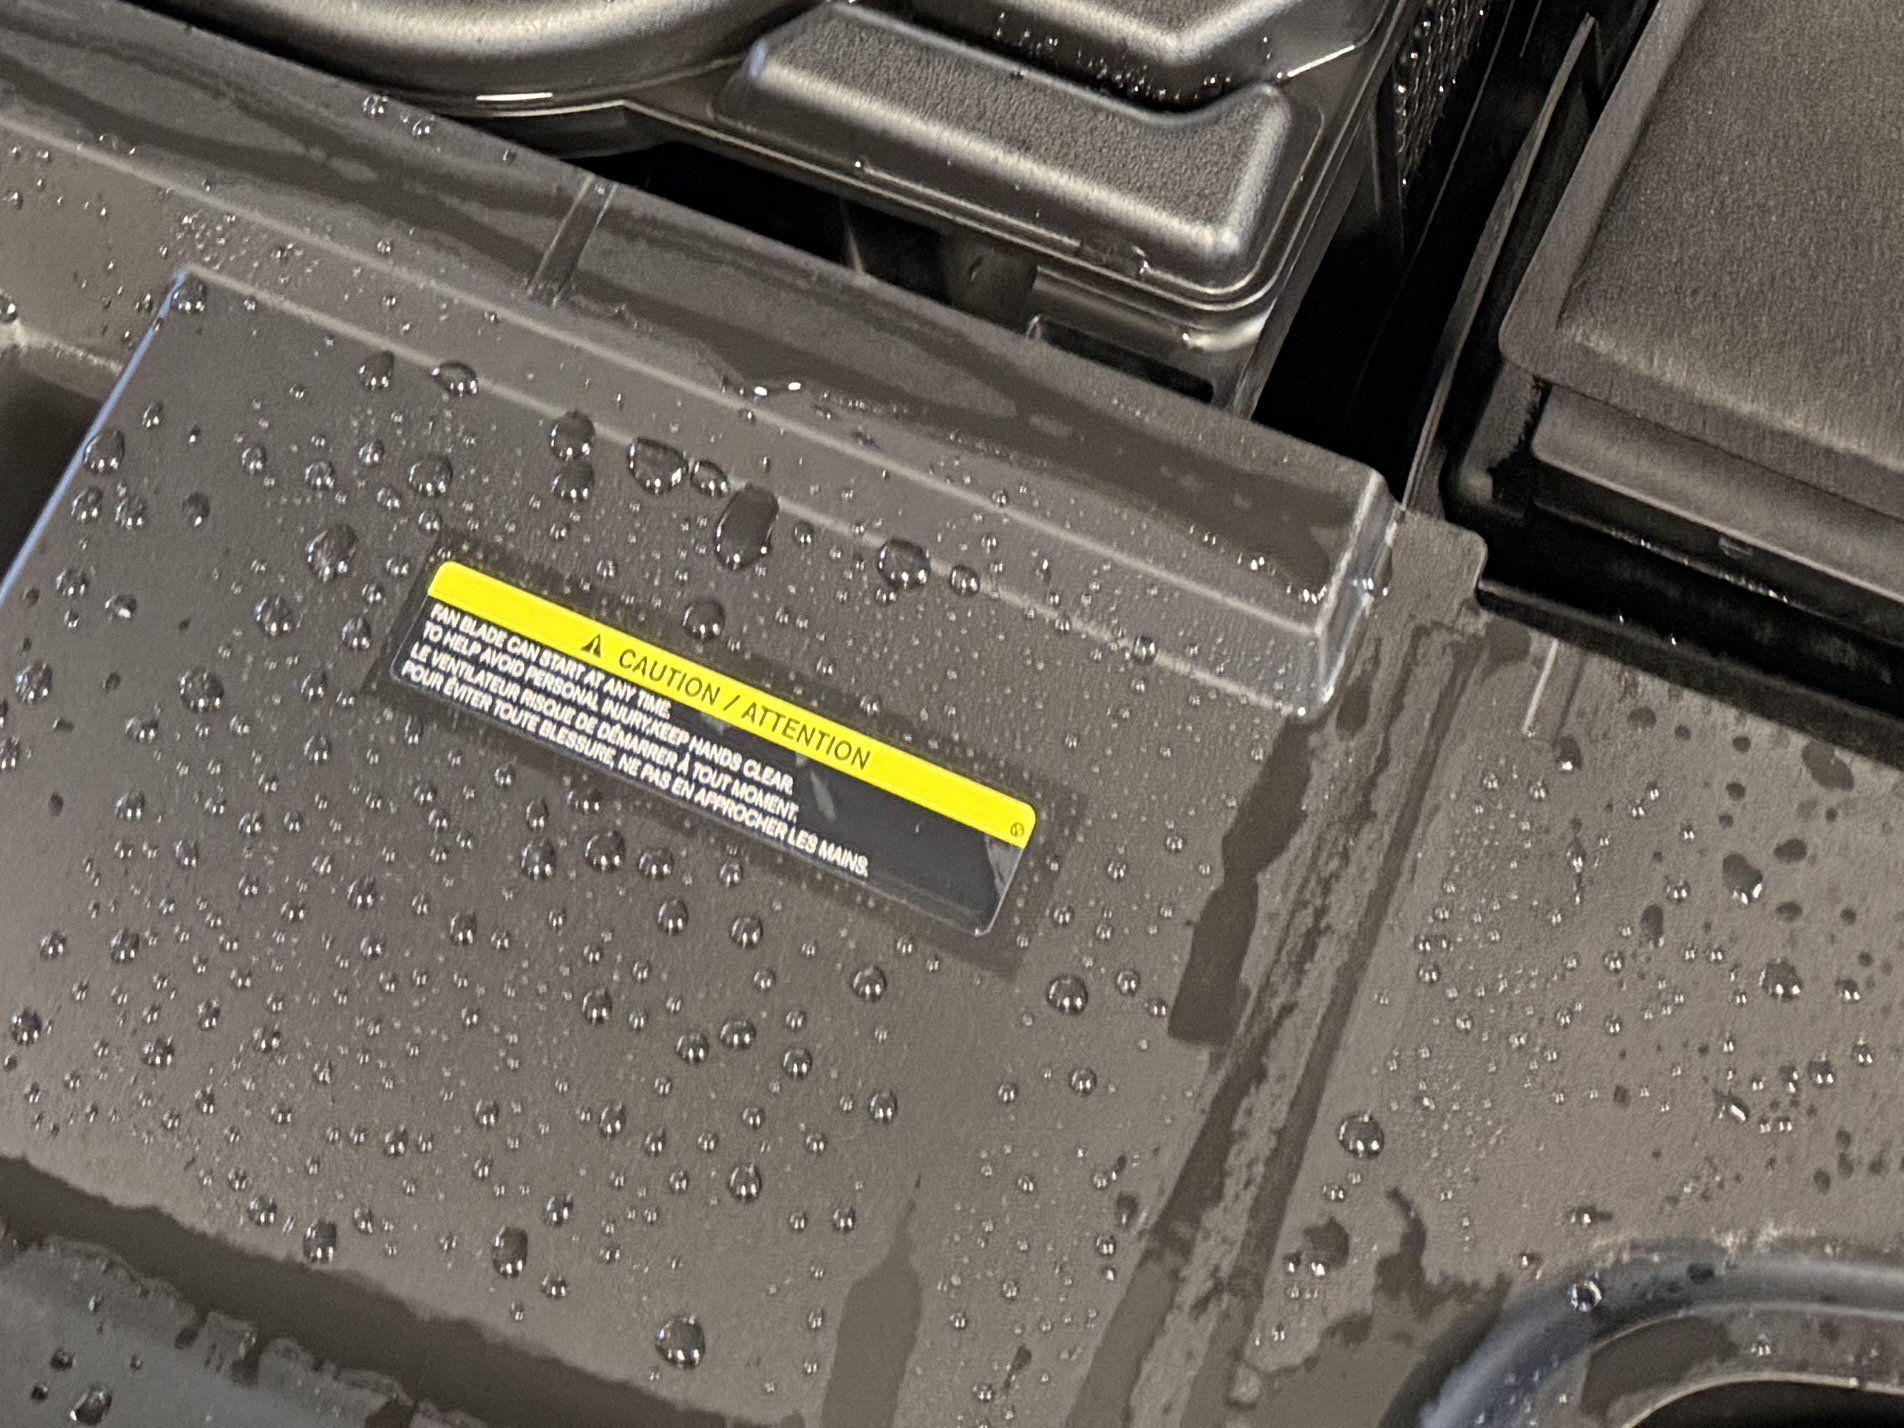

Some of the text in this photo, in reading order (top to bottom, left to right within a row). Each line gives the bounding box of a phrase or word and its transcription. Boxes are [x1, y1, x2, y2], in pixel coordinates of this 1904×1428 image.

[409, 641, 431, 662] LE
[431, 650, 520, 700] VENTILATEUR
[519, 688, 575, 724] RISQUE
[574, 711, 598, 734] DE
[597, 721, 677, 768] DÉMARRER
[692, 761, 732, 791] TOUT
[422, 620, 443, 642] TO
[442, 630, 481, 656] HELP
[479, 647, 525, 677] AVOID
[524, 665, 598, 711] PERSONAL
[688, 736, 742, 771] HANDS
[430, 602, 460, 628] FAN
[458, 615, 507, 647] BLADE
[506, 635, 540, 662] CAN
[538, 649, 585, 679] START
[582, 669, 605, 689] AT
[602, 677, 636, 702] ANY
[618, 648, 720, 704] CAUTION
[741, 702, 870, 768] ATTENTION
[401, 660, 444, 690] POUR
[443, 675, 492, 711] ÉVITER
[493, 698, 540, 732] TOUTE
[617, 753, 641, 776] NE
[639, 763, 671, 789] PAS
[670, 776, 695, 799] EN
[694, 788, 787, 839] APPROCHER
[786, 826, 818, 853] LES
